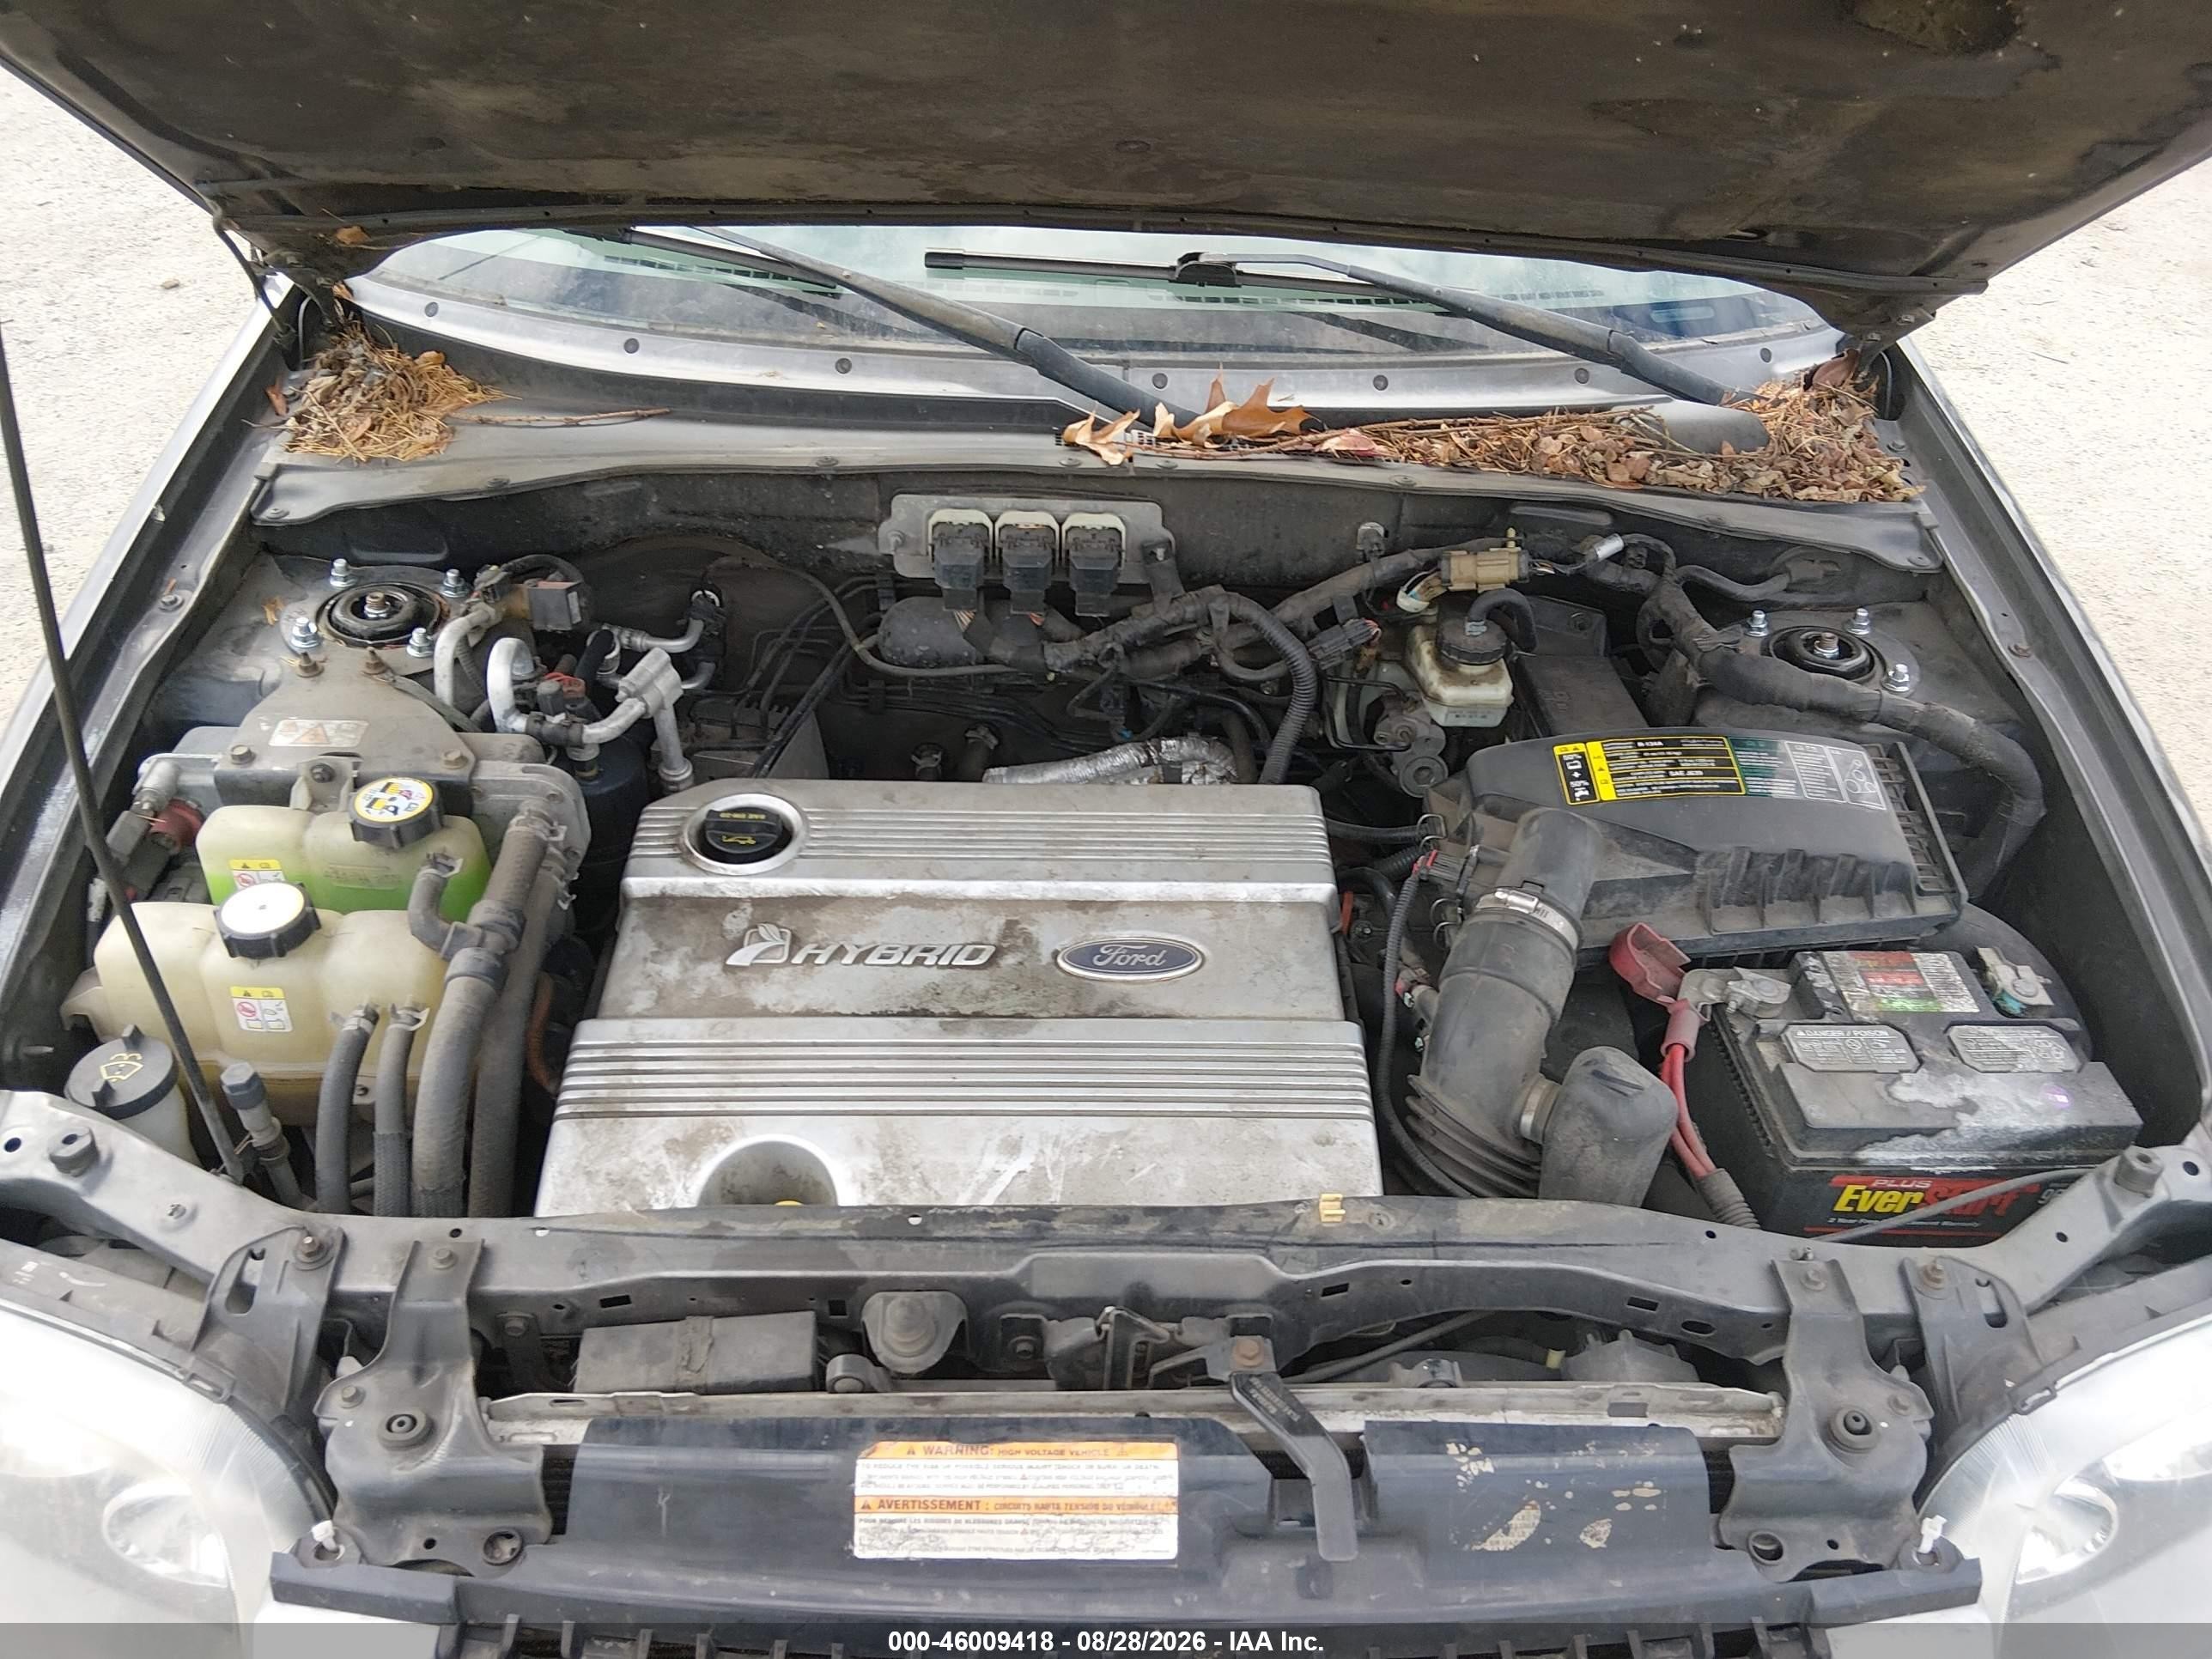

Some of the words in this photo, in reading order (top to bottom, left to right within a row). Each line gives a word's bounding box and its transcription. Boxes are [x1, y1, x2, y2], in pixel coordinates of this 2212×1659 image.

[791, 944, 996, 967] HYBRID
[1092, 943, 1167, 970] Ford
[1872, 1179, 1932, 1189] PLUS
[922, 1445, 994, 1456] WARNING:
[878, 1499, 981, 1511] AVERTISSEMENT
[994, 1503, 1031, 1511] CIRCUITS
[1034, 1503, 1060, 1511] HAUTE
[1064, 1503, 1100, 1511] TENSION
